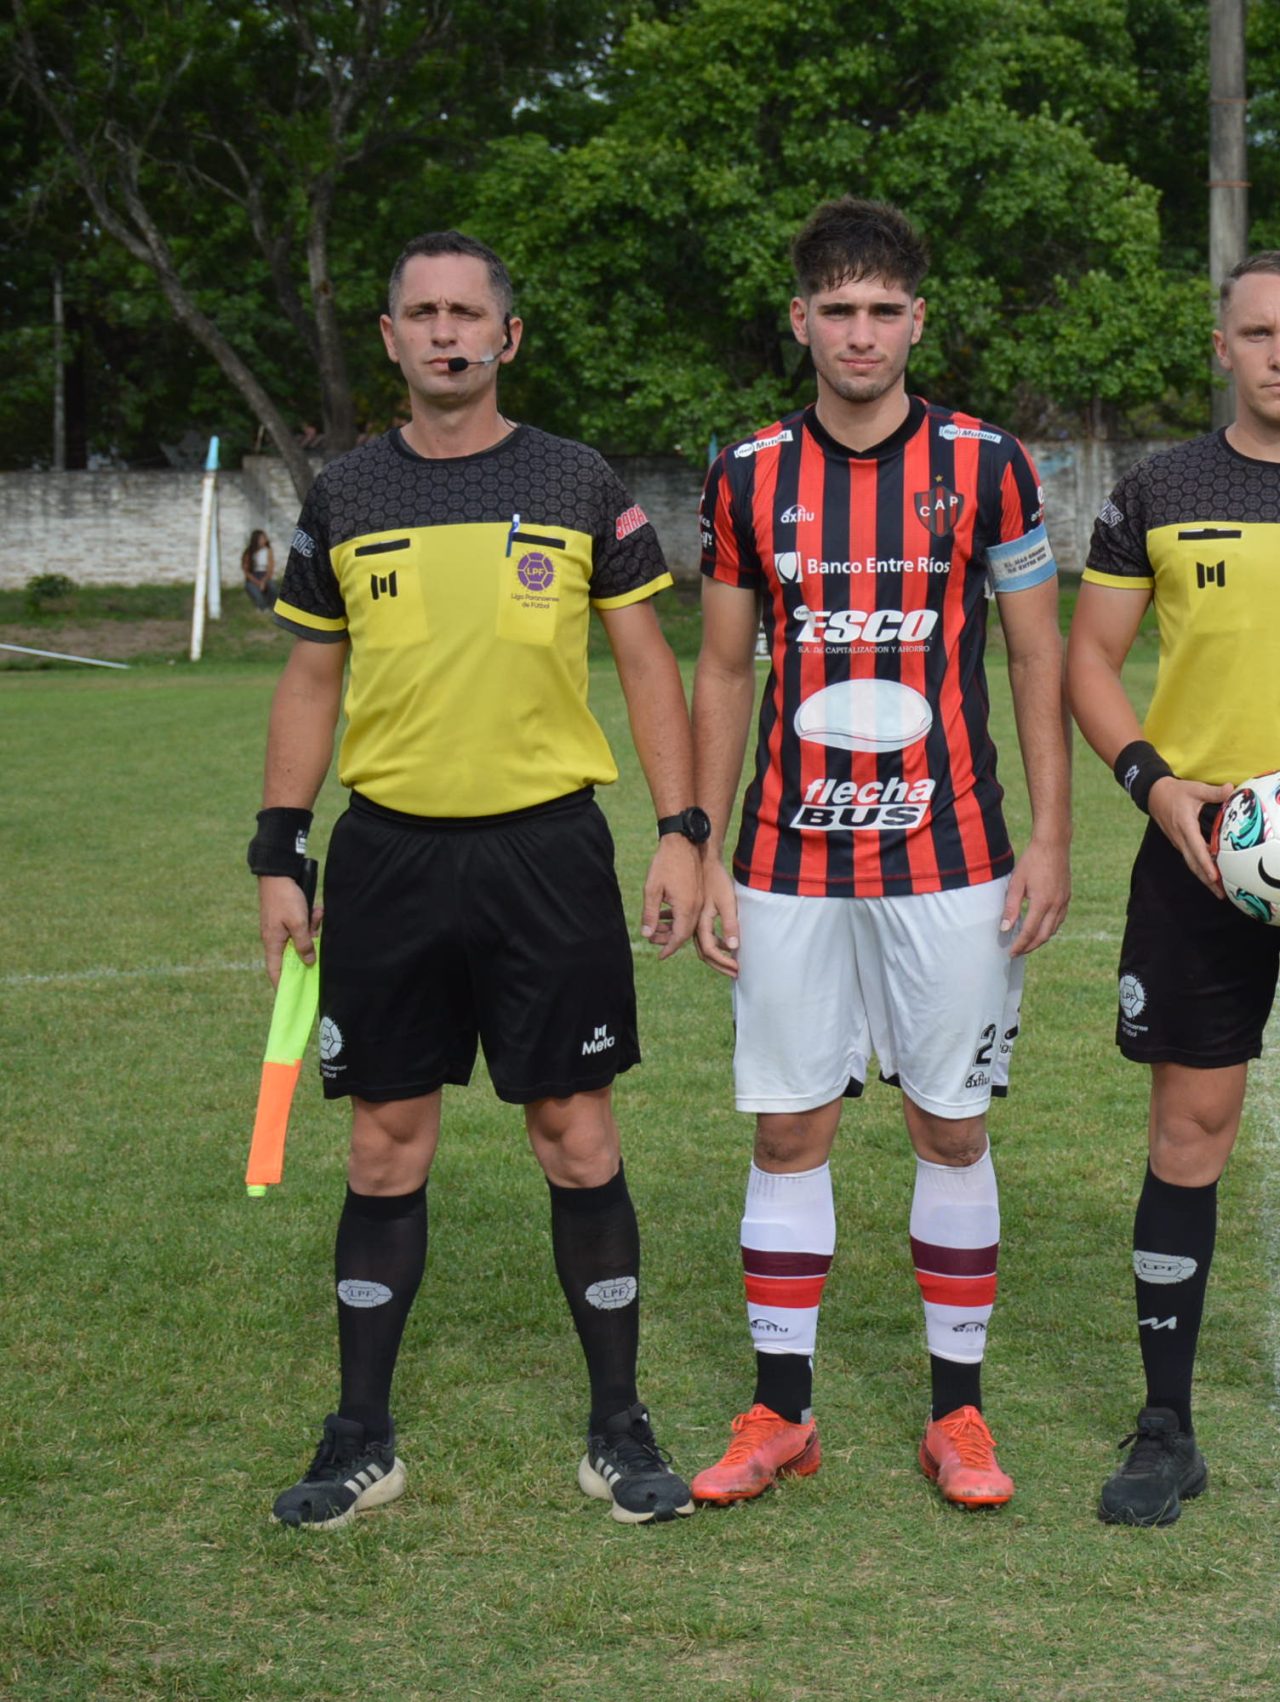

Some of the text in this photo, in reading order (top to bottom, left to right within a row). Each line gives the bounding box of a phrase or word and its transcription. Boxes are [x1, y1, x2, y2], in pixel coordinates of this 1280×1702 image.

[961, 429, 997, 441] Mutual
[526, 568, 546, 576] LPF
[807, 556, 952, 575] Banco Entre Ríos
[898, 645, 931, 653] AHORRO
[804, 777, 937, 804] flecha
[799, 805, 922, 828] BUS
[582, 1032, 616, 1055] Meta
[350, 1288, 374, 1298] LPF
[602, 1286, 627, 1299] LPF
